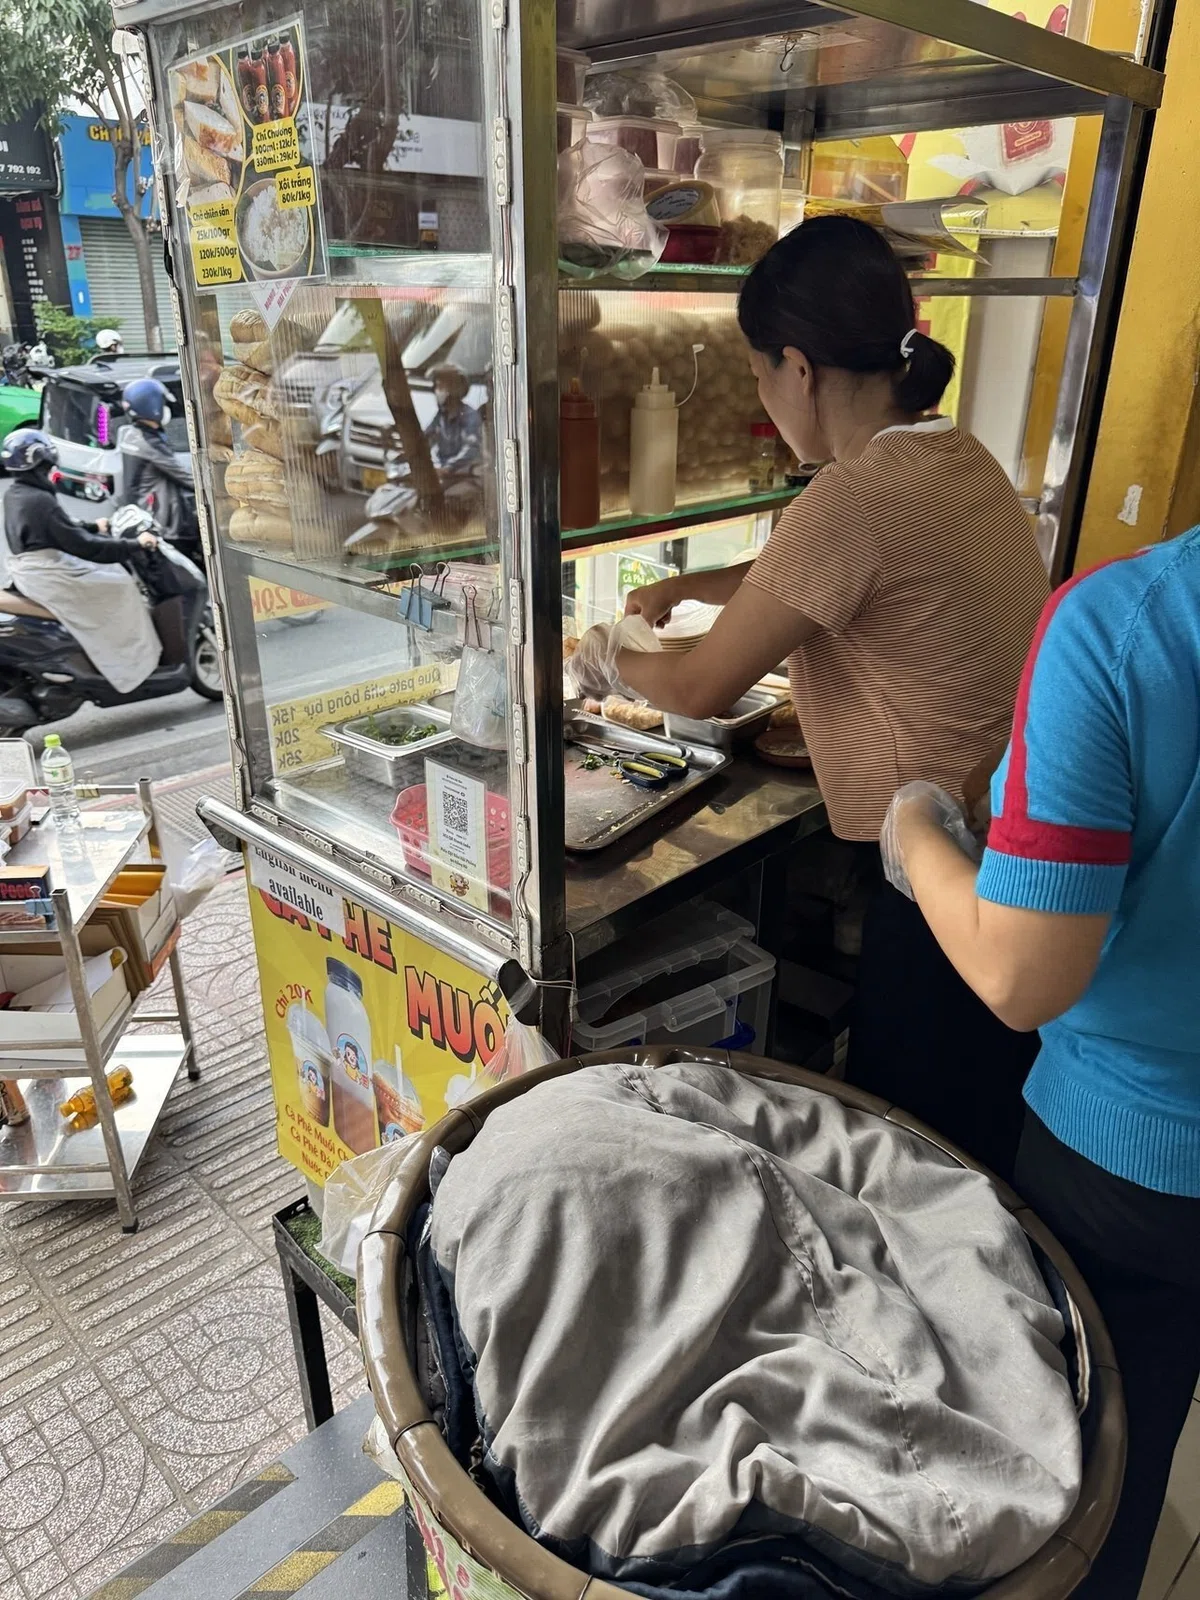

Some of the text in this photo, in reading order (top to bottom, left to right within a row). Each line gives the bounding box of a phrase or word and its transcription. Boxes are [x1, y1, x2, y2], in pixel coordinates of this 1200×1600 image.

[7, 164, 25, 174] 792
[278, 173, 312, 190] Xôi trắng
[281, 190, 311, 204] 80k/1kg
[199, 246, 238, 260] 120k/500gr
[202, 265, 232, 279] 230k/1kg
[269, 878, 324, 921] available
[404, 965, 511, 1068] MUỐ
